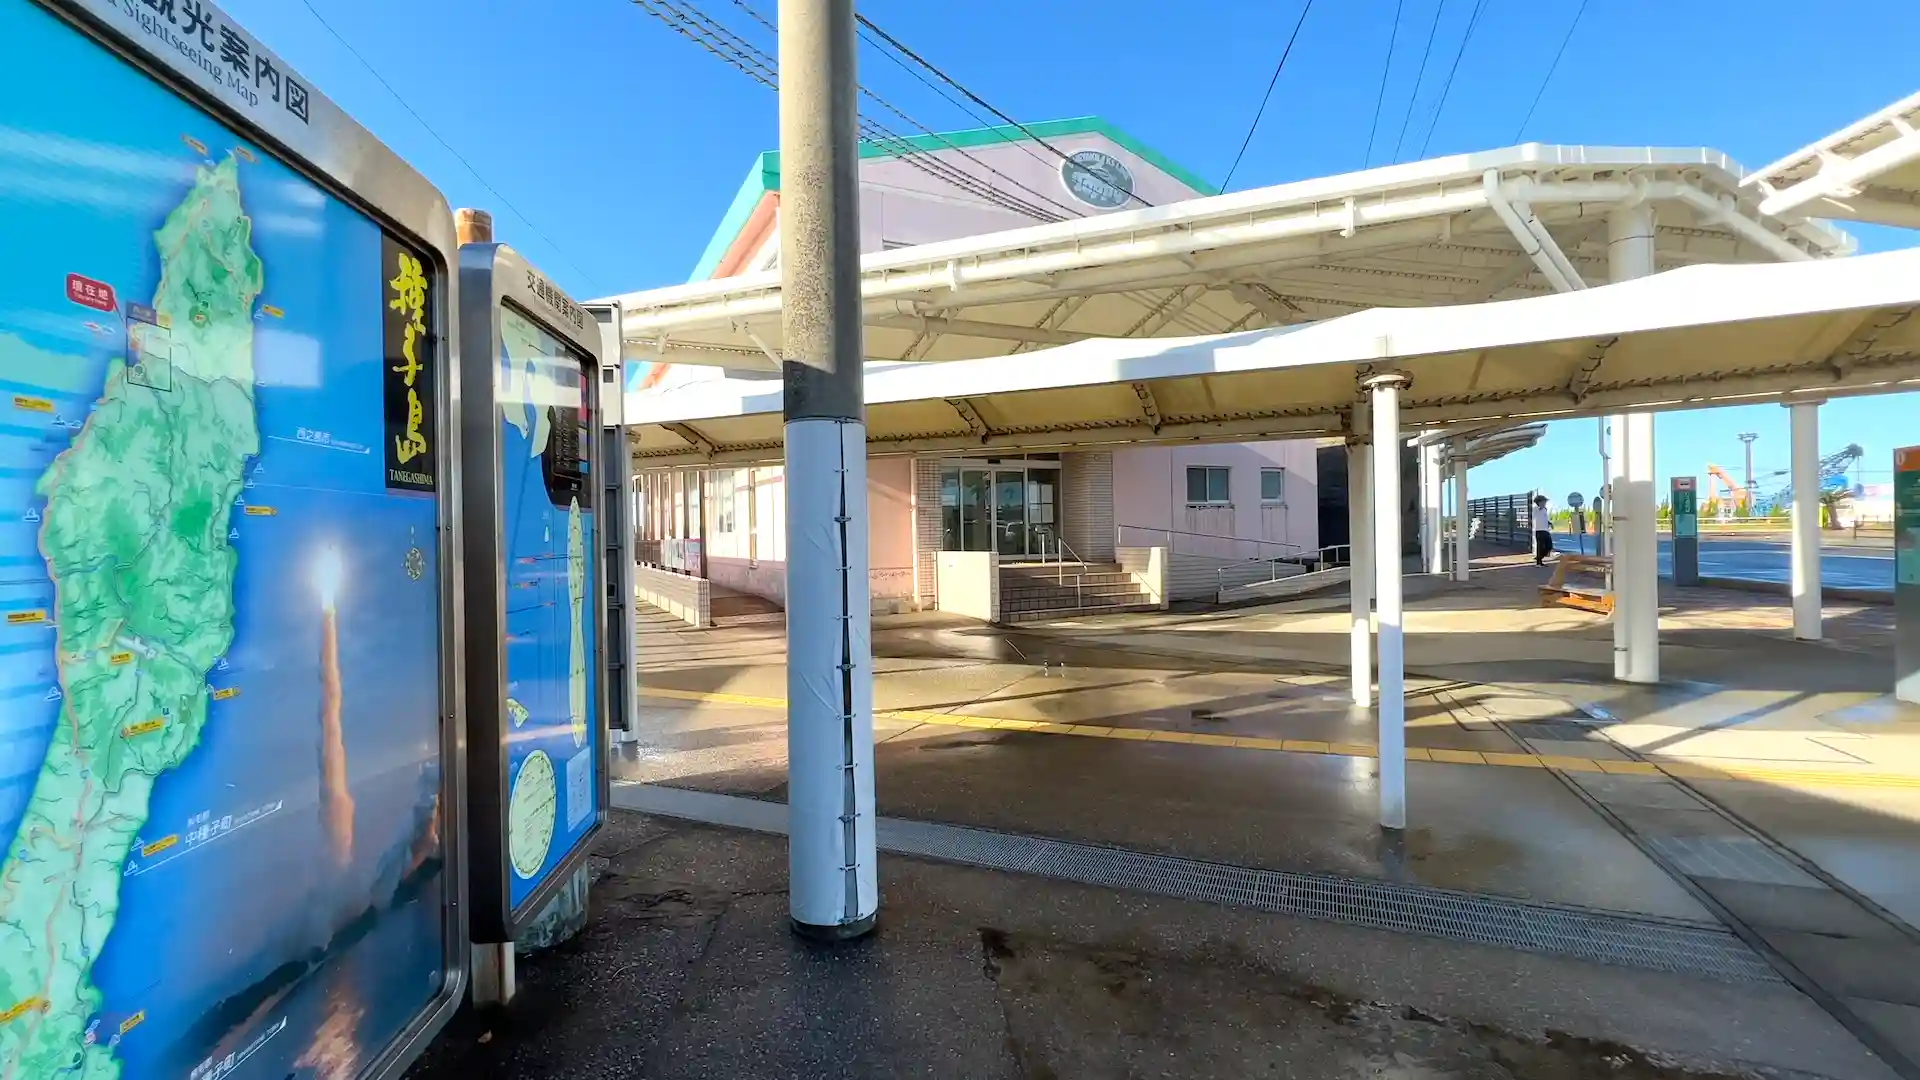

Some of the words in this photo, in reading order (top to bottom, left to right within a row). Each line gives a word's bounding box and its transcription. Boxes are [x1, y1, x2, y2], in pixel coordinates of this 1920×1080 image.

[123, 0, 222, 85] Sightseeing
[227, 70, 259, 108] Map
[72, 279, 108, 300] 現在地
[389, 468, 434, 486] TANEGASHIMA
